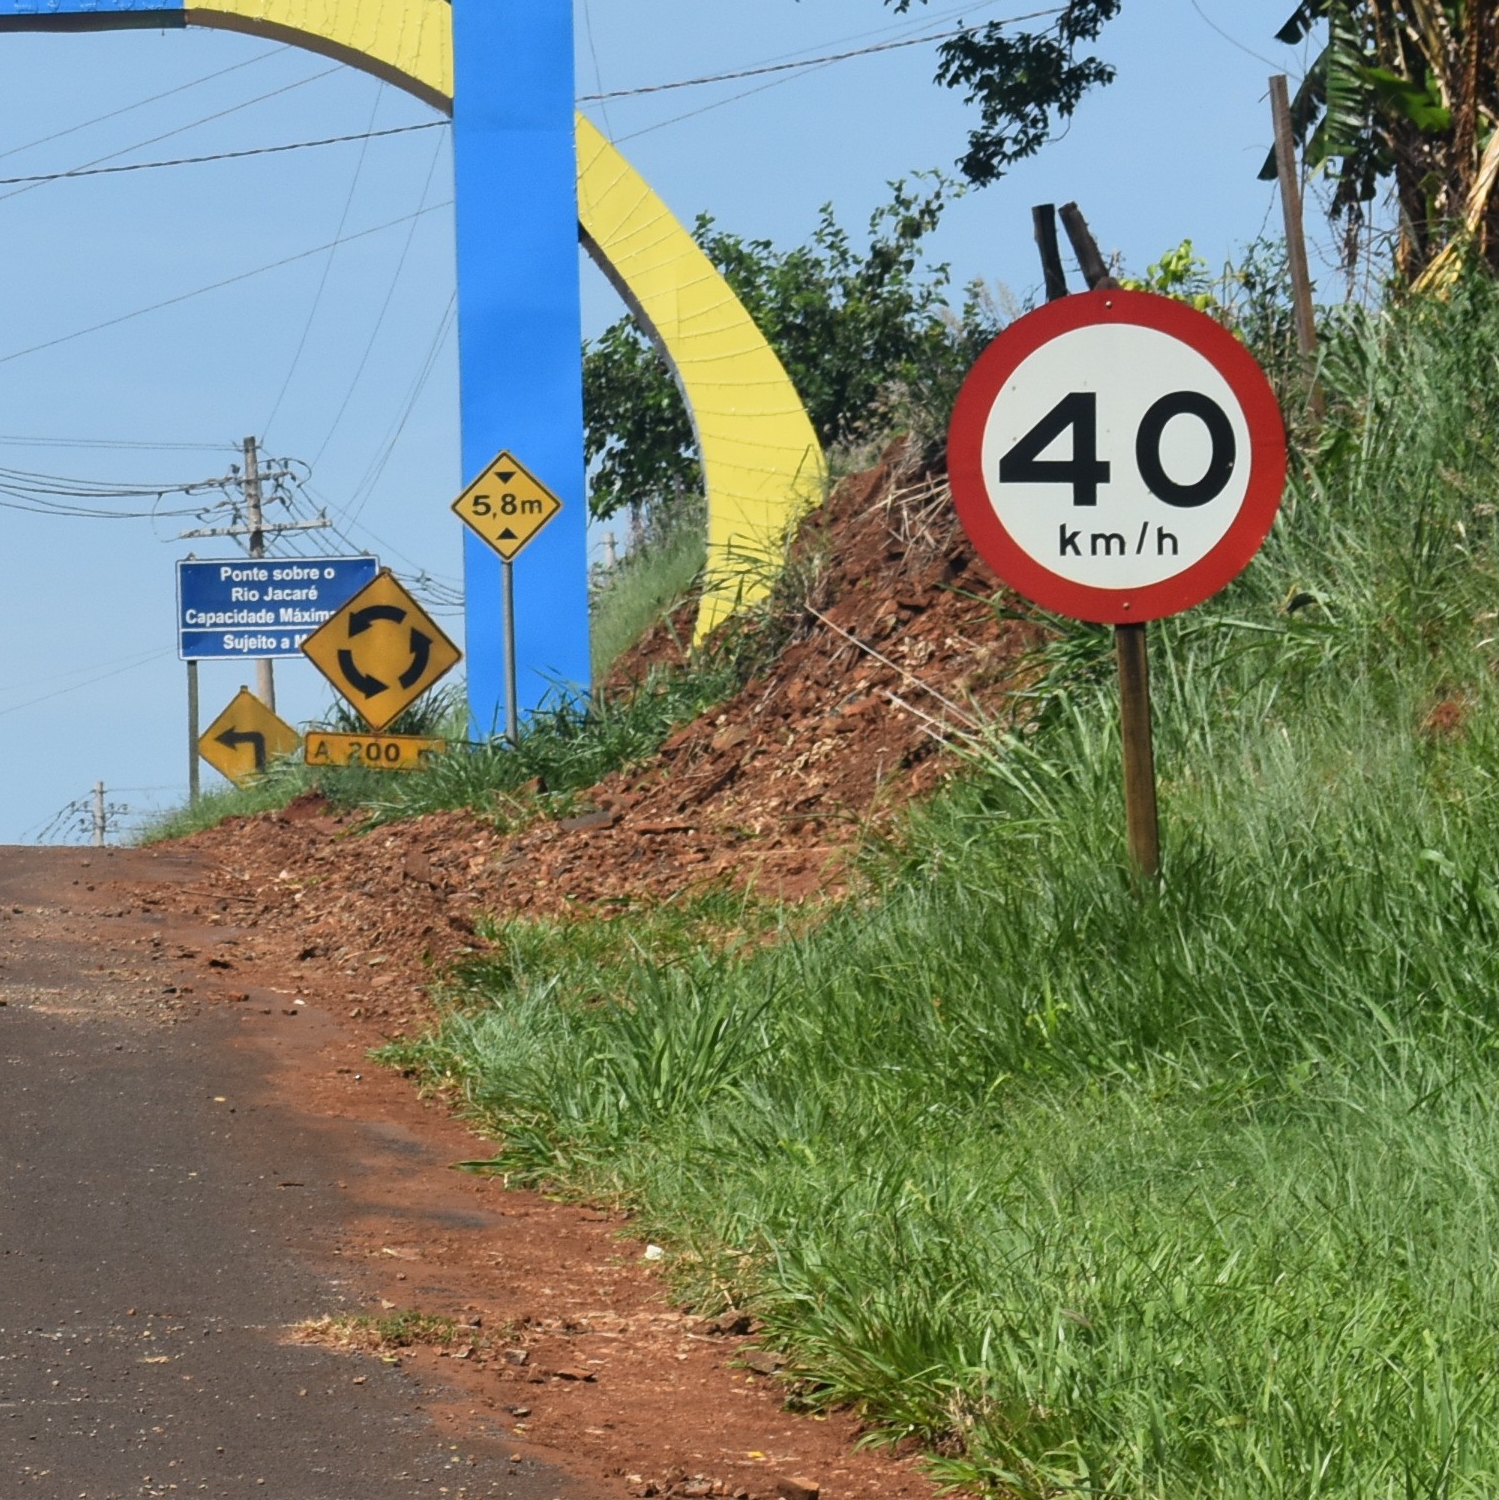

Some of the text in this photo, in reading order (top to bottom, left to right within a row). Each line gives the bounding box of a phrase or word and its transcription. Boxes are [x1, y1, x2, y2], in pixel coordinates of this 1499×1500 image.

[999, 391, 1236, 508] 40
[1059, 521, 1179, 557] km/h
[220, 566, 335, 581] Ponte sobre o
[231, 585, 318, 601] Rio Jacaré
[185, 607, 335, 626] Capacidade Máxim
[223, 634, 276, 652] Sujeito
[280, 637, 289, 649] a
[314, 740, 329, 760] A
